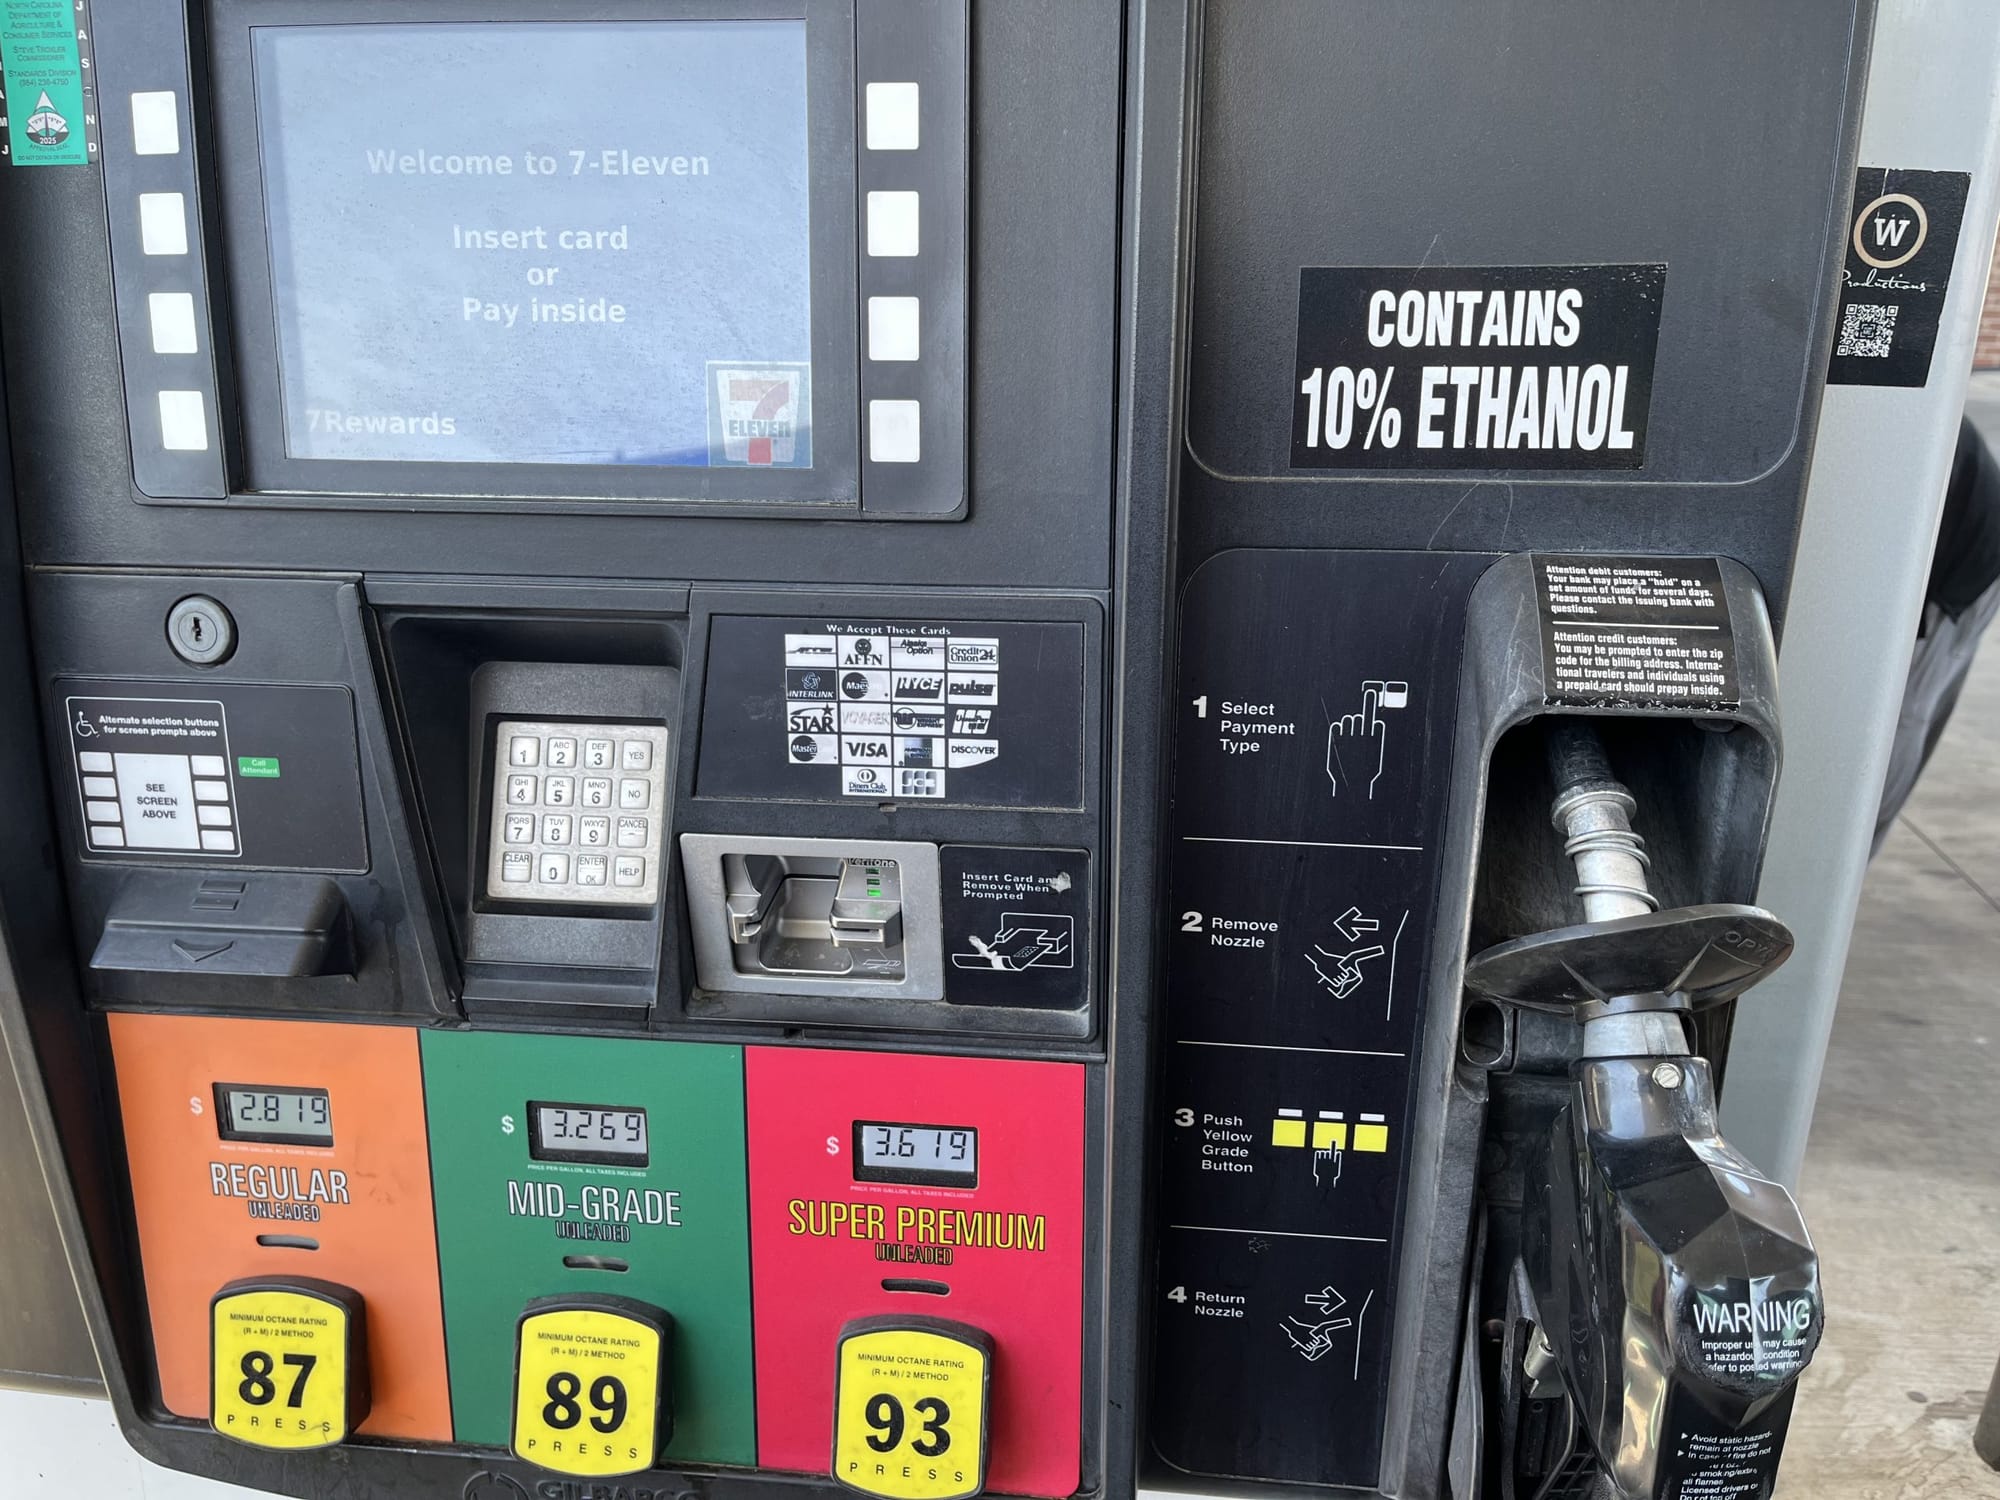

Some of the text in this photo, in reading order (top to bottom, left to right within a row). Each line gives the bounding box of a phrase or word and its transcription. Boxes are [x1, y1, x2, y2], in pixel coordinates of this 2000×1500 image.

[39, 137, 57, 145] 2025
[366, 149, 710, 176] Welcome to 7-Eleven
[453, 224, 628, 250] Insert card
[1874, 217, 1911, 247] W
[526, 265, 559, 286] or
[463, 297, 626, 328] Pay inside
[1368, 288, 1583, 347] CONTAINS
[1301, 364, 1634, 450] 10% ETHANOL
[305, 409, 457, 436] 7Rewards
[1546, 565, 1662, 577] Attention debit customers:
[1550, 593, 1715, 607] Please contact the issuing bank with
[1551, 604, 1598, 614] questions.
[826, 624, 951, 635] We Accept These Cards
[1553, 631, 1678, 645] Attention credit customers:
[1554, 643, 1723, 660] You may be prompted to enter the zip
[844, 653, 883, 665] AFFN
[1555, 654, 1723, 670] code for the billing address. Interna-
[1556, 667, 1725, 685] tional travelers and individuals using
[899, 677, 940, 690] NYCE
[1556, 680, 1723, 696] a prepaid card should prepay inside.
[789, 690, 834, 698] INTERLINK
[1193, 696, 1208, 718] 1
[1221, 702, 1275, 716] Select
[99, 715, 219, 727] Alternate selection buttons
[790, 716, 836, 732] STAR
[1221, 720, 1295, 736] Payment
[103, 725, 217, 737] for screen prompts above
[845, 742, 888, 757] VISA
[951, 745, 996, 755] DISCOVER
[1220, 738, 1260, 754] Type
[520, 751, 528, 763] 1
[556, 752, 566, 764] 2
[594, 753, 603, 765] 3
[629, 752, 644, 760] YES
[145, 784, 166, 792] SEE
[517, 789, 526, 801] 4
[628, 790, 640, 798] NO
[137, 797, 178, 806] SCREEN
[554, 790, 563, 802] 5
[591, 792, 601, 804] 6
[142, 810, 177, 819] ABOVE
[618, 819, 647, 828] CANCEL
[514, 827, 523, 839] 7
[551, 829, 560, 840] 8
[589, 830, 599, 843] 9
[504, 854, 529, 863] CLEAR
[579, 857, 605, 866] ENTER
[586, 875, 597, 883] OK
[619, 868, 640, 876] HELP
[962, 872, 999, 882] Insert
[1003, 873, 1033, 883] Card
[962, 881, 1049, 893] Remove When
[963, 890, 1023, 900] Prompted
[1181, 912, 1203, 932] 2
[1211, 917, 1278, 932] Remove
[1211, 934, 1265, 948] Nozzle
[190, 1094, 327, 1124] $ 2.819
[1174, 1108, 1195, 1127] 3
[1204, 1113, 1243, 1127] Push
[502, 1110, 641, 1141] $ 3.269
[1203, 1129, 1252, 1142] Yellow
[826, 1127, 967, 1160] $ 3.619
[1202, 1145, 1249, 1157] Grade
[1201, 1159, 1253, 1173] Button
[209, 1162, 350, 1204] REGULAR
[507, 1180, 682, 1227] MID-GRADE
[248, 1200, 321, 1222] UNLEADED
[555, 1221, 631, 1243] UNLEADED
[788, 1199, 1046, 1251] SUPER PREMIUM
[875, 1242, 953, 1265] UNLEADED
[1167, 1286, 1187, 1303] 4
[1195, 1291, 1245, 1304] Return
[1194, 1305, 1244, 1318] Nozzle
[1693, 1299, 1810, 1333] WARNING
[230, 1313, 328, 1326] MINIMUM OCTANE RATING
[538, 1332, 641, 1348] MINIMUM OCTANE RATING
[1702, 1338, 1807, 1350] Improper may cause
[858, 1353, 964, 1369] MINIMUM OCTANE RATING
[1762, 1349, 1800, 1359] condition
[239, 1350, 317, 1408] 87
[913, 1372, 949, 1381] METHOD
[542, 1371, 628, 1433] 89
[228, 1414, 330, 1432] PRESS
[865, 1393, 951, 1457] 93
[1691, 1434, 1717, 1443] Avoid
[528, 1439, 638, 1459] PRESS
[1689, 1443, 1720, 1452] remain
[850, 1463, 963, 1482] PRESS
